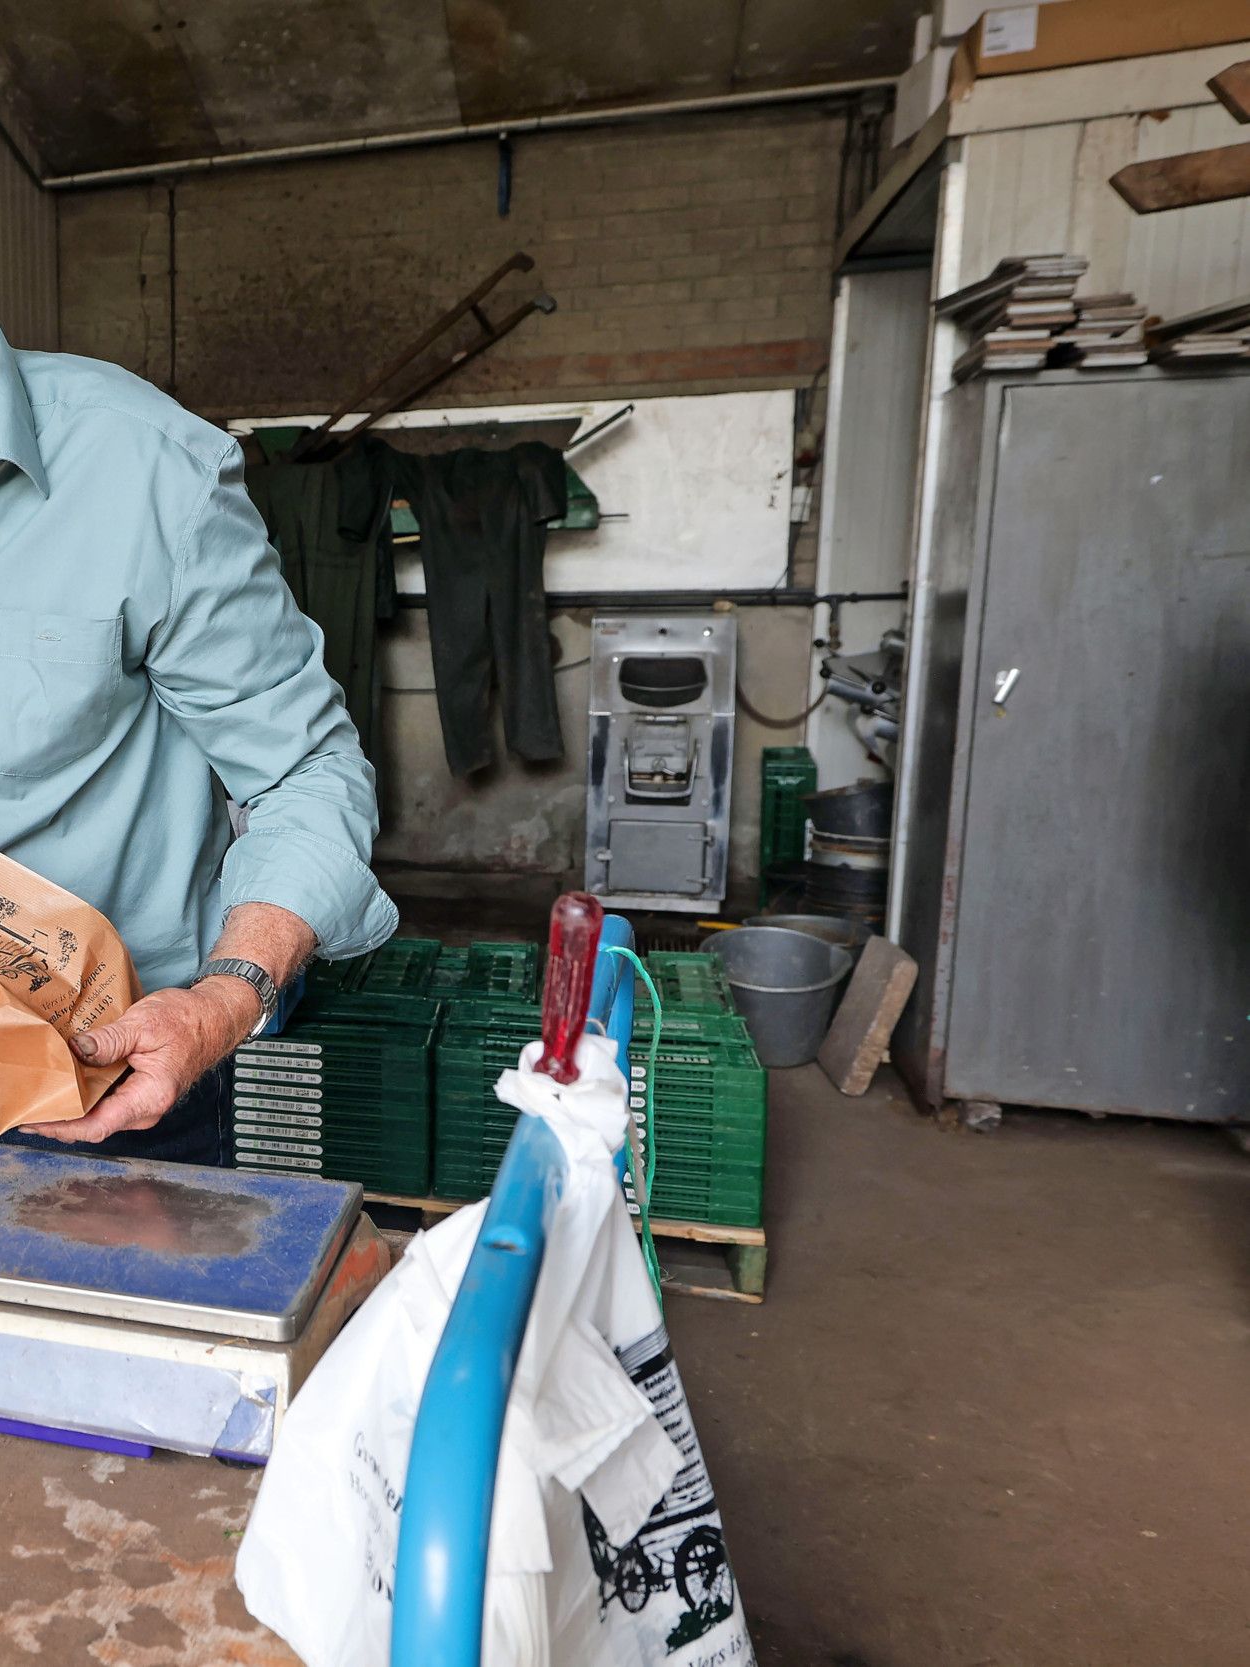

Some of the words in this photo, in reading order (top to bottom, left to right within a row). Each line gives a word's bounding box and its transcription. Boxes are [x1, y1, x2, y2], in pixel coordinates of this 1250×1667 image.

[85, 973, 117, 1005] Middelbeers
[94, 1003, 106, 1015] 14
[101, 994, 114, 1006] 93
[731, 1634, 742, 1655] is
